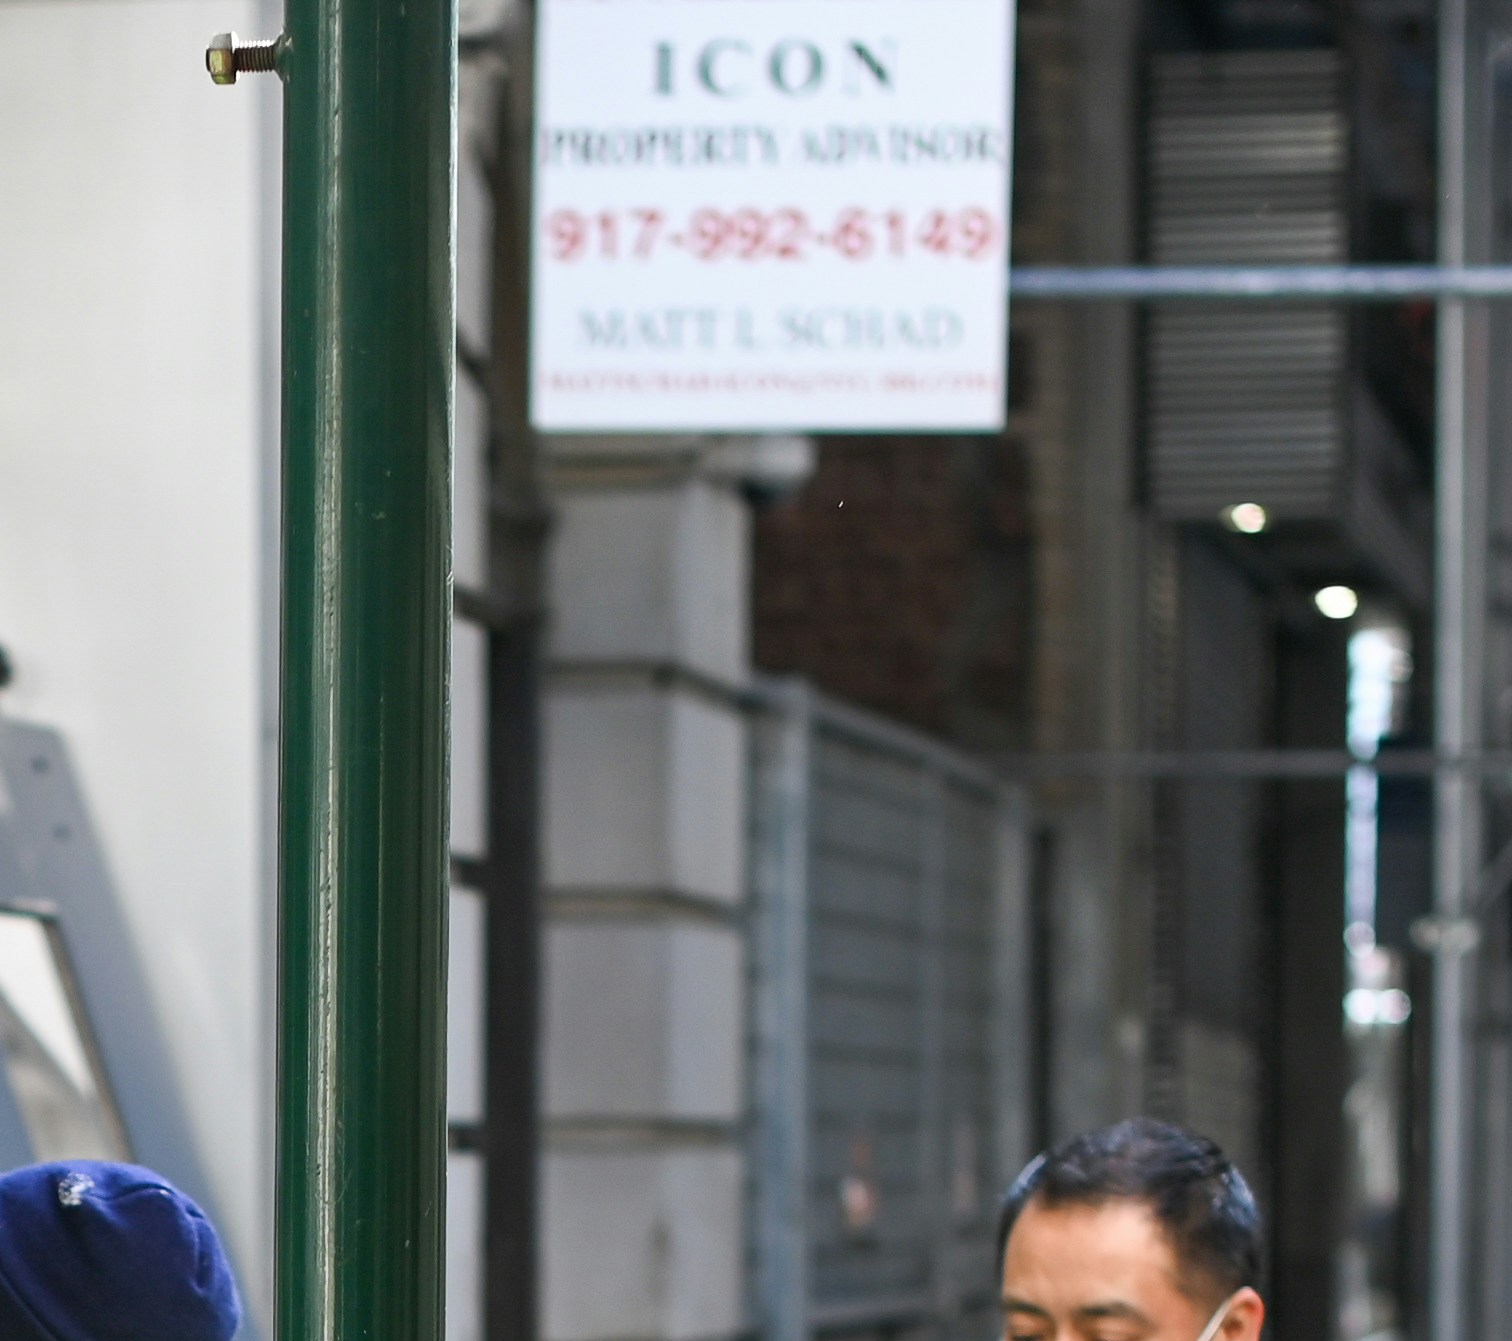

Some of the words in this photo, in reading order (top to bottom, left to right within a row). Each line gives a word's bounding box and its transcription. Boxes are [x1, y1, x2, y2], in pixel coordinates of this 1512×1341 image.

[652, 37, 898, 97] ICON
[546, 124, 779, 166] PROPERTY
[547, 206, 998, 262] 917-992-6149
